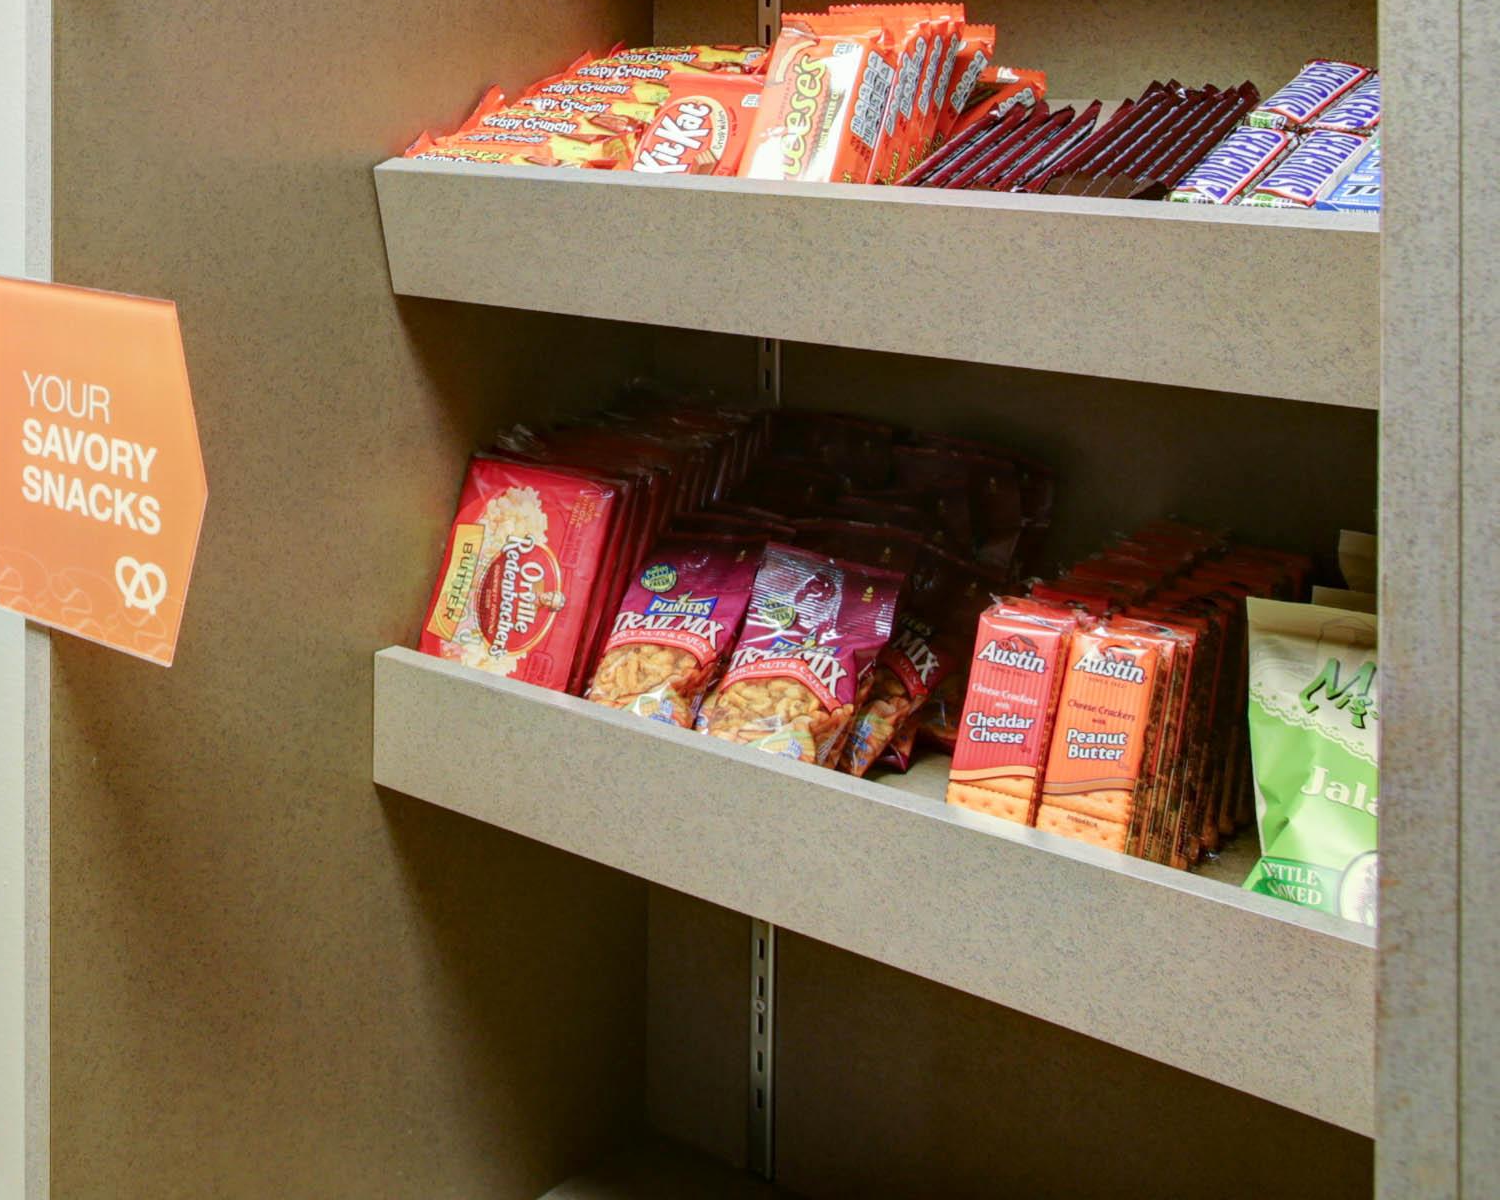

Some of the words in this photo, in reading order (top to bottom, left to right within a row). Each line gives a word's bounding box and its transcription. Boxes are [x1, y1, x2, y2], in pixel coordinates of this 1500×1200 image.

[618, 65, 668, 80] Crunchy
[579, 82, 630, 94] Crunchy
[559, 99, 610, 113] Crunchy
[483, 115, 522, 130] Crispy
[523, 117, 577, 135] Crunchy
[1258, 130, 1362, 198] SNICKERS
[22, 371, 111, 424] YOUR
[22, 418, 157, 483] SAVORY
[22, 466, 161, 535] SNACKS
[443, 542, 475, 621] BUTTER
[514, 560, 546, 634] Orville
[649, 599, 712, 616] PLANTERS
[612, 611, 677, 636] TRAIL
[675, 616, 724, 649] MIX
[977, 639, 1047, 674] Austin
[1073, 651, 1145, 685] Austin
[798, 648, 847, 698] MIX
[966, 712, 1034, 730] Cheddar
[1067, 698, 1097, 714] Cheese
[1098, 706, 1136, 722] Crackers
[968, 727, 1025, 745] Cheese
[1066, 728, 1127, 746] Peanut
[1067, 744, 1124, 761] Butter
